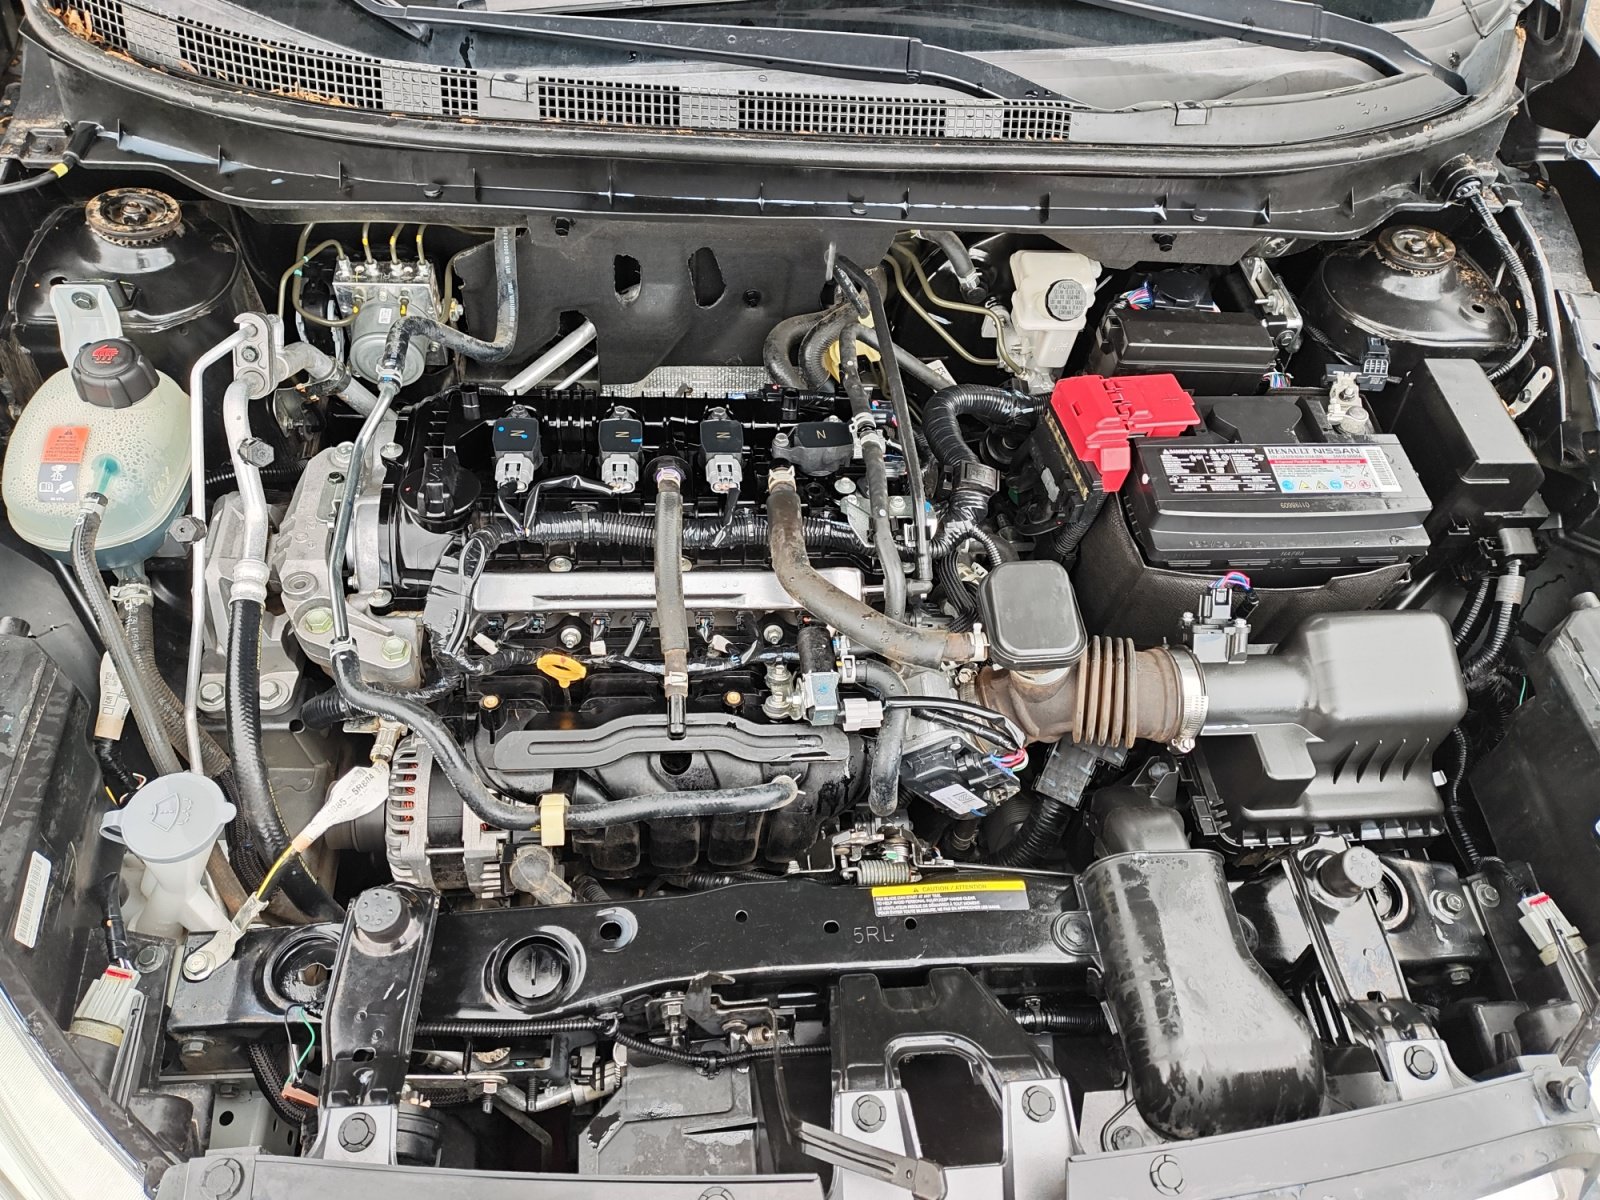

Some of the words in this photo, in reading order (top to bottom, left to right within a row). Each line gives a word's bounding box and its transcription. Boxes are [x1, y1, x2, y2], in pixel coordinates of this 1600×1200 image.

[815, 429, 826, 439] N
[922, 885, 949, 893] CAUTION
[853, 925, 894, 944] 5RL
